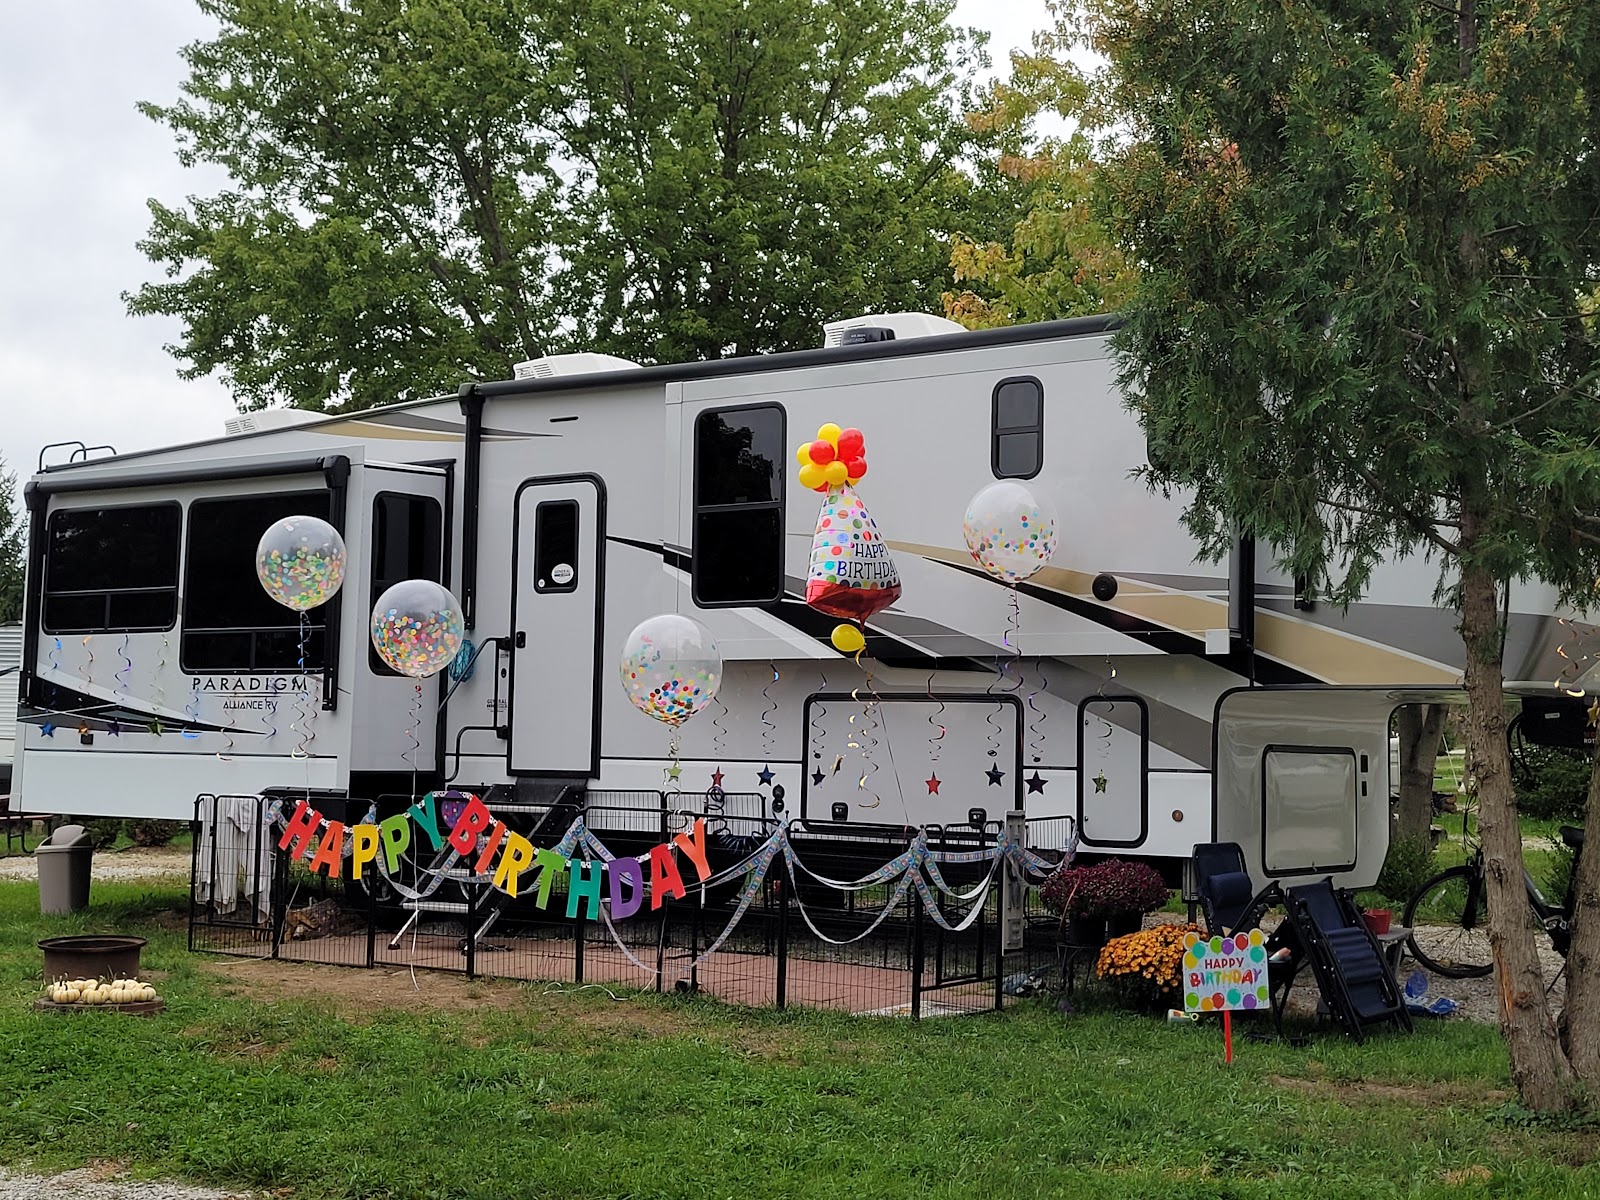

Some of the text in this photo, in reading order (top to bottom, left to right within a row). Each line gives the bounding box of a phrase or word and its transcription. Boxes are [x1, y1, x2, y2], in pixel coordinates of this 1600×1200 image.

[837, 559, 898, 579] BIRTHDA
[192, 676, 308, 691] PARADIGM
[223, 700, 278, 711] ALLIANCE RV
[278, 791, 712, 920] HAPPY BIRTHDAY
[1205, 957, 1244, 969] HAPPY
[1189, 968, 1261, 988] BIRTHDAY
